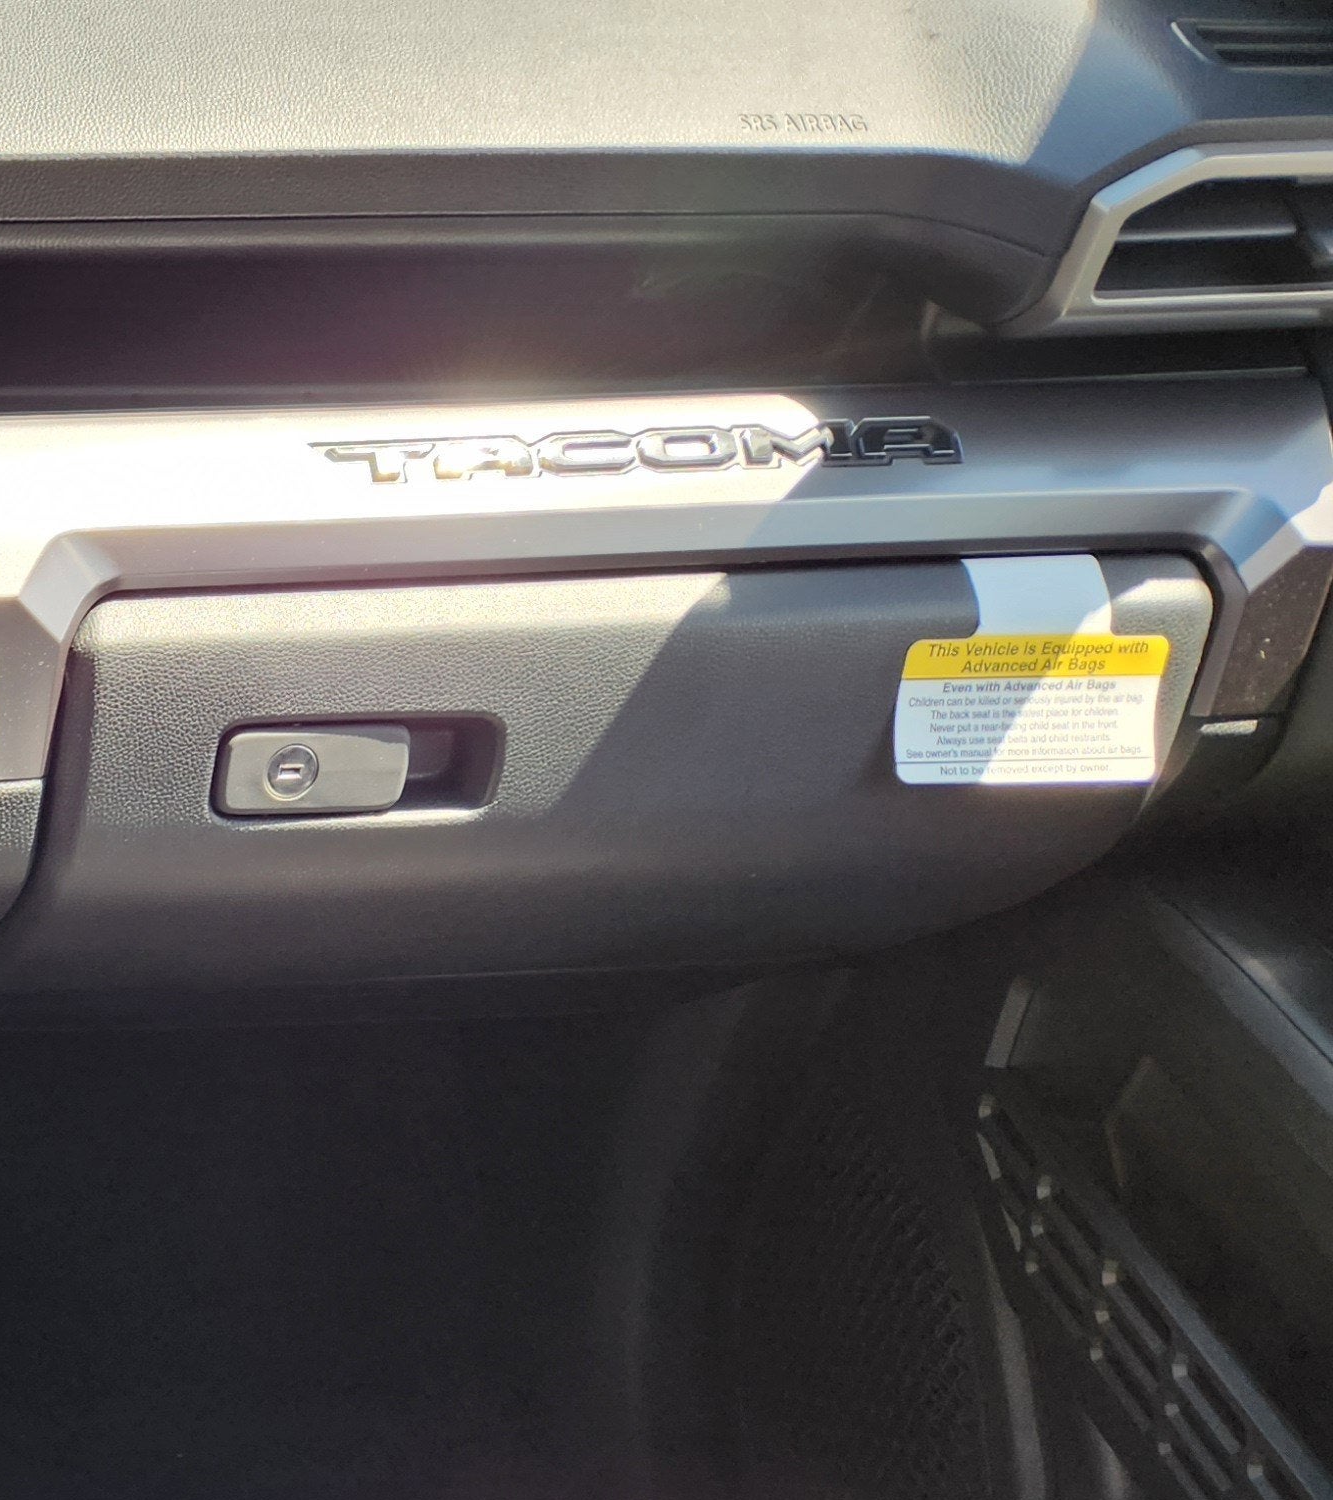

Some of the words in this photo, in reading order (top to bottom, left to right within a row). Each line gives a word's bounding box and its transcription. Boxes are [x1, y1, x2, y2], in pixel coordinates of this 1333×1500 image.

[738, 113, 778, 131] SRS
[784, 112, 868, 133] AIRBAG
[307, 416, 964, 484] TACOMA
[928, 643, 959, 657] This
[966, 642, 1019, 656] Vehicle
[1041, 640, 1114, 657] Equipped
[1118, 641, 1149, 653] with
[961, 658, 1039, 673] Advanced
[1040, 658, 1064, 672] Air
[1068, 657, 1106, 674] Bags
[942, 682, 972, 693] Even
[976, 681, 1000, 692] with
[1003, 680, 1062, 692] Advanced
[1065, 679, 1084, 691] Air
[1086, 679, 1117, 692] Bags
[909, 696, 945, 707] Children
[946, 697, 963, 706] can
[965, 696, 976, 706] be
[978, 695, 1001, 706] killed
[1002, 697, 1013, 705] or
[1085, 694, 1095, 704] by
[1098, 694, 1111, 703] the
[1114, 694, 1125, 702] air
[931, 709, 947, 720] The
[949, 709, 970, 719] back
[972, 709, 991, 719] seat
[992, 709, 1001, 718] is
[1002, 709, 1016, 718] the
[1046, 709, 1069, 719] place
[1071, 708, 1082, 716] for
[929, 723, 955, 733] Never
[957, 723, 973, 732] put
[1029, 721, 1050, 730] child
[1052, 721, 1070, 730] seat
[1072, 721, 1080, 729] in
[1081, 720, 1095, 729] the
[936, 735, 966, 746] Always
[969, 737, 985, 745] use
[987, 735, 1005, 744] seat
[1007, 734, 1028, 743] belts
[1030, 734, 1047, 743] and
[1049, 733, 1069, 743] child
[906, 749, 923, 759] See
[926, 748, 958, 758] owner's
[961, 748, 992, 757] manual
[1007, 748, 1029, 756] more
[1081, 745, 1106, 755] about
[1108, 745, 1117, 754] air
[940, 766, 958, 776] Not
[960, 765, 970, 775] to
[972, 765, 984, 775] be
[987, 765, 1028, 774] removed
[1031, 764, 1064, 774] except
[1065, 764, 1078, 773] by
